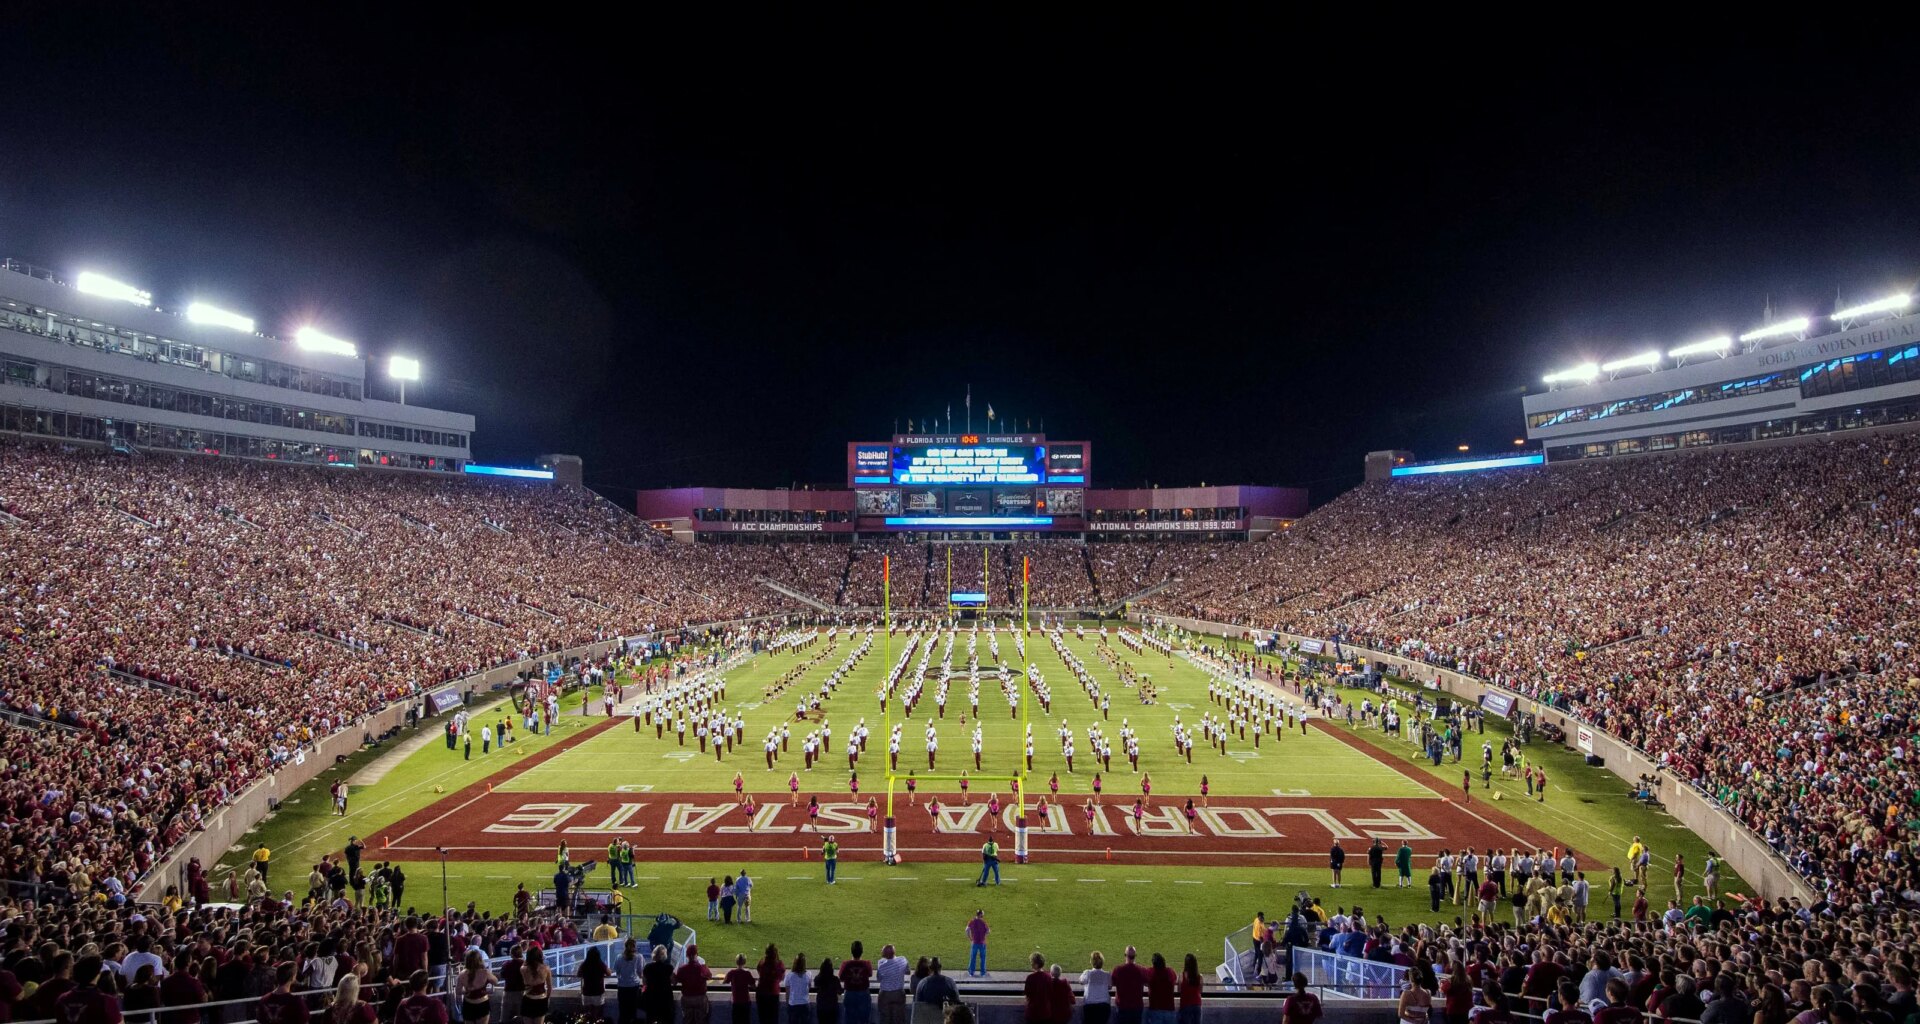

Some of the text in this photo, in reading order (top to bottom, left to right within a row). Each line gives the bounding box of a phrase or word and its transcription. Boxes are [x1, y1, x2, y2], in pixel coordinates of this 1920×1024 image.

[1758, 350, 1797, 367] BOBBY
[857, 450, 888, 459] StubHub!
[732, 523, 822, 531] 14 ACC CHAMPIONSHIPS
[1090, 522, 1131, 530] NATIONAL
[1134, 522, 1181, 530] CHAMPIONS
[1221, 521, 1236, 529] 2013
[480, 802, 1446, 840] FLORIDA STATE
